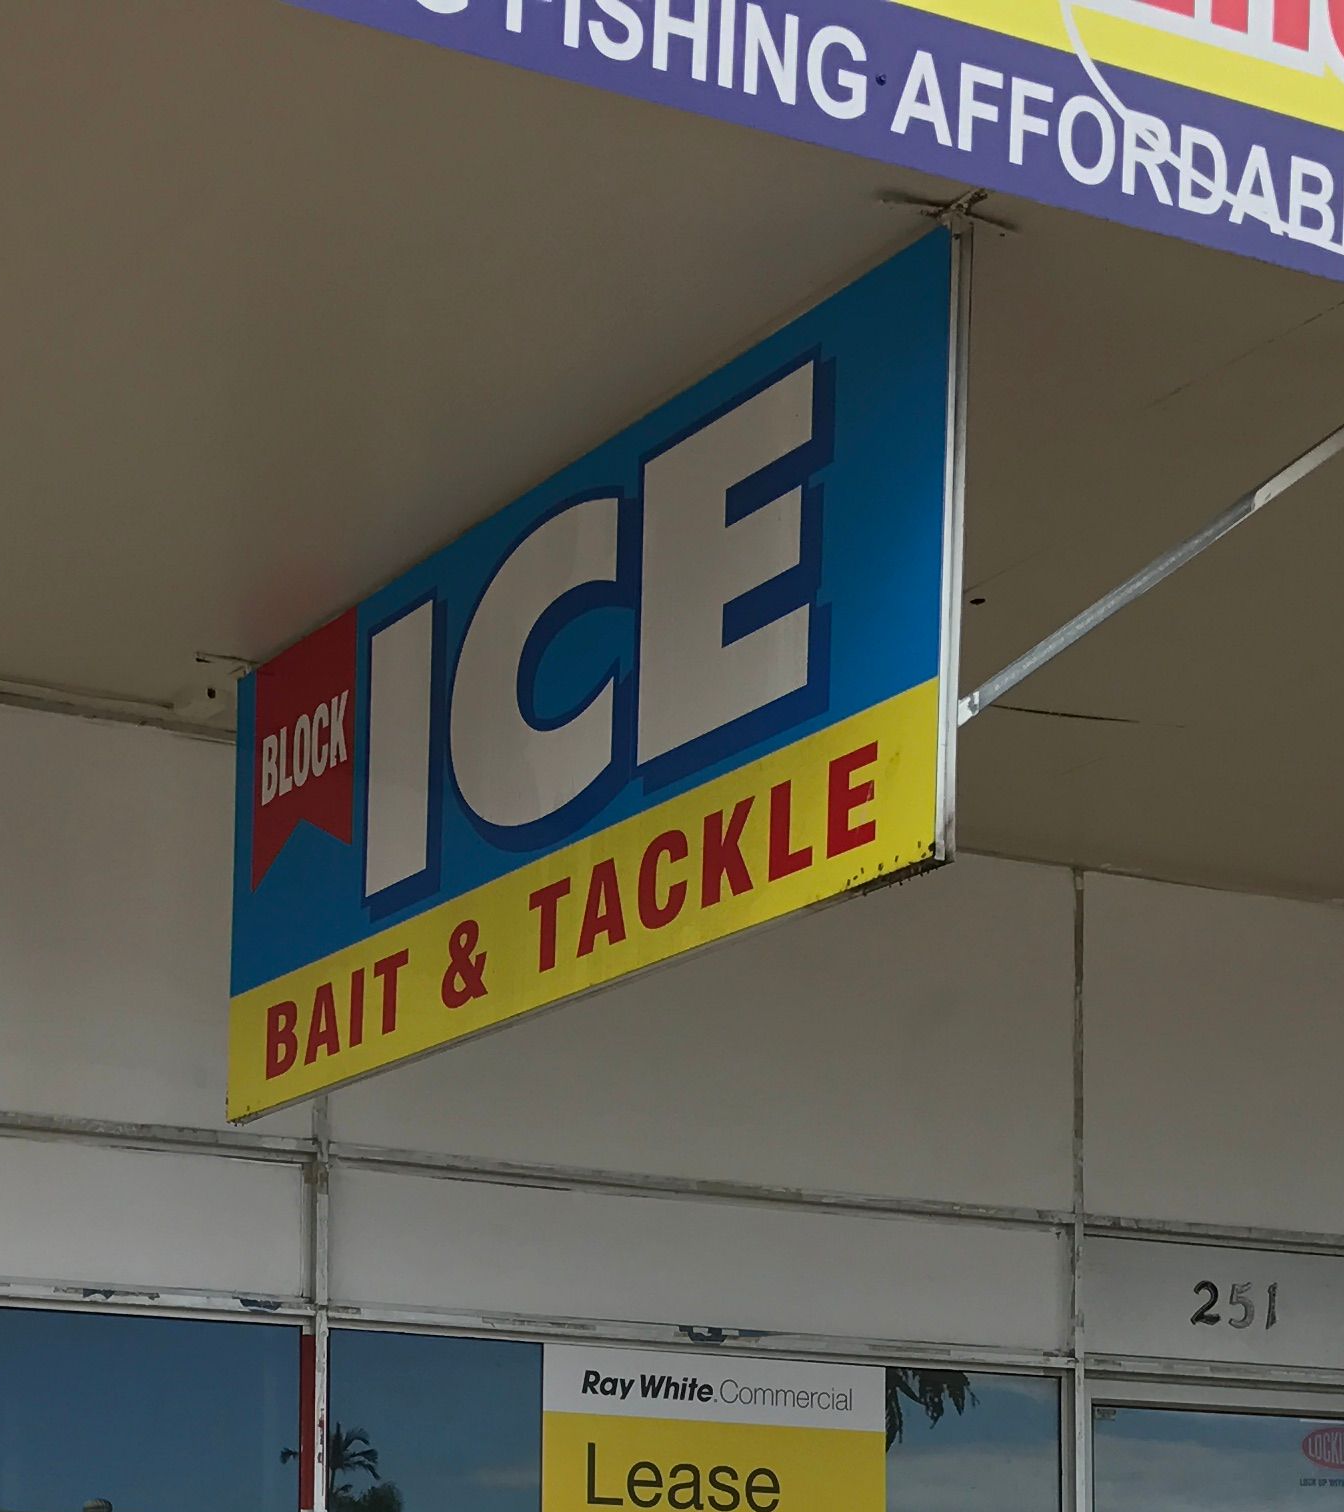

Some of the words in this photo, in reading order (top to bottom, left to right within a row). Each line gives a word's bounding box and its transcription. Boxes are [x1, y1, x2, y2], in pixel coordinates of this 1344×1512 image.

[363, 358, 816, 900] ICE
[260, 689, 350, 807] BLOCK
[264, 951, 410, 1081] BAIT
[440, 918, 489, 1009] &
[528, 740, 880, 974] TACKLE
[1189, 1279, 1279, 1330] 251
[581, 1369, 635, 1401] Ray
